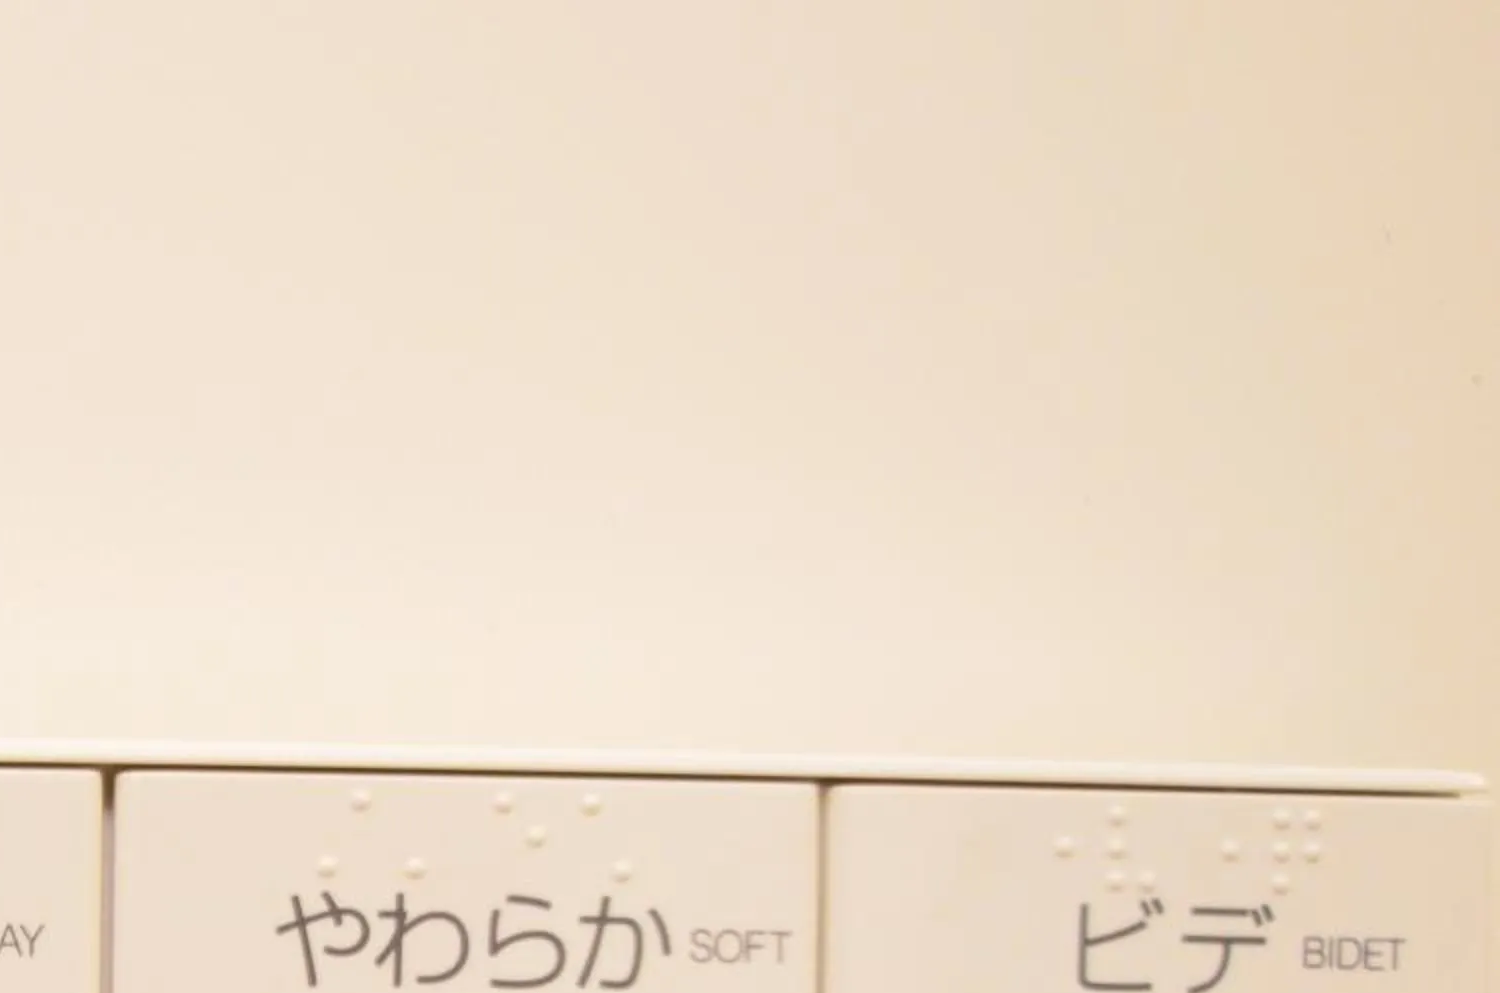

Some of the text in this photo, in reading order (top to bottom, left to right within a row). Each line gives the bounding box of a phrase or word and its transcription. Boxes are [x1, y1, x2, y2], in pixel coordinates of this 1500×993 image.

[276, 890, 673, 991] やわらか
[690, 928, 791, 964] SOFT
[1302, 935, 1406, 972] BIDET
